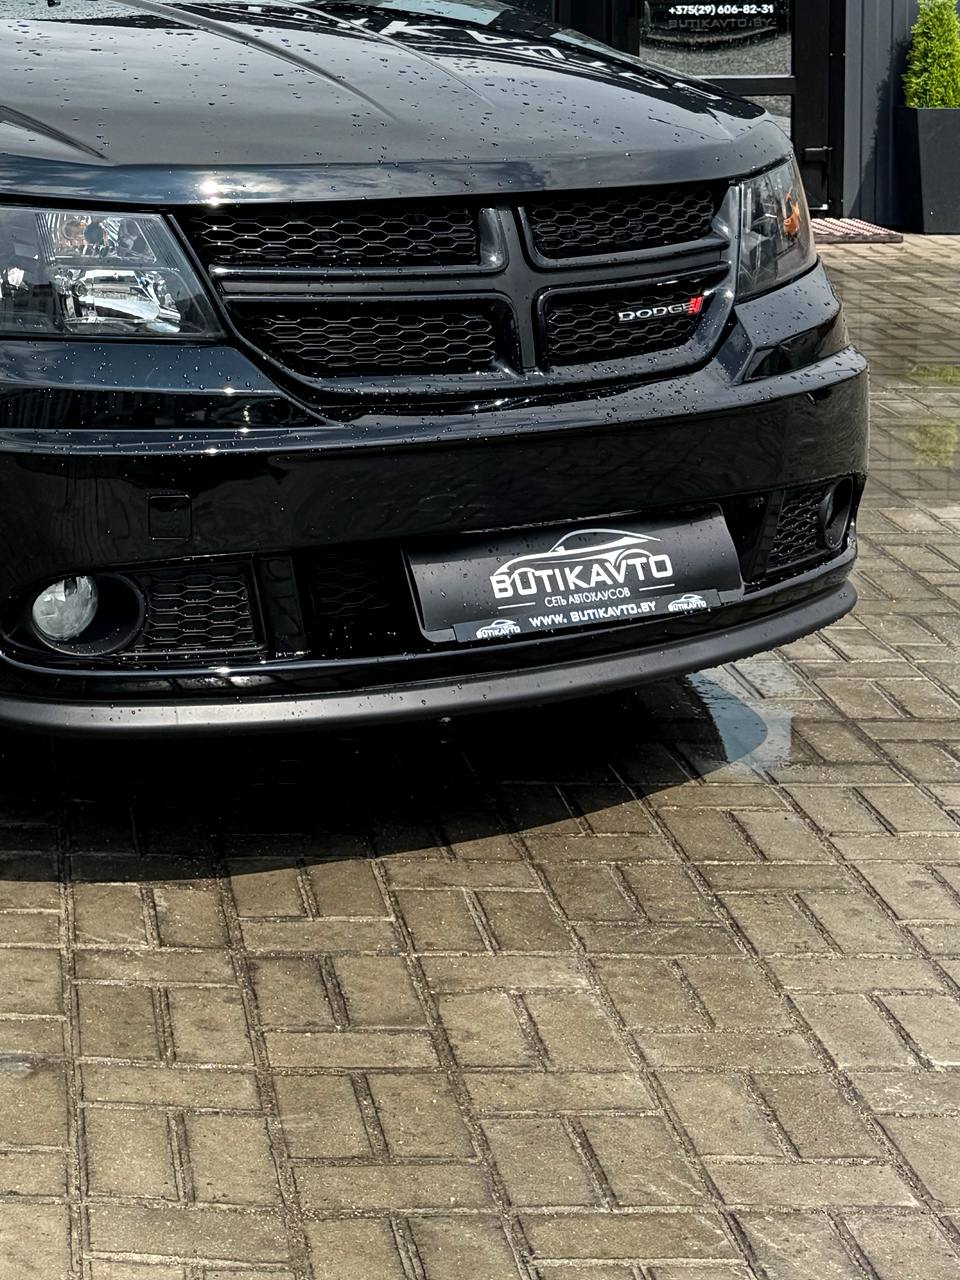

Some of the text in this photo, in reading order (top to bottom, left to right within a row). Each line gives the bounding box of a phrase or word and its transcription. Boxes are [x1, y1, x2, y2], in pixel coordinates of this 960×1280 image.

[668, 4, 774, 16] +375(29) 606-82-31
[618, 303, 696, 321] DODGE
[490, 554, 673, 599] BUTIKAVTO
[544, 587, 631, 608] СЕТЬ АВТОХАУСОВ
[529, 601, 656, 628] WWW. BUTIKAVTO.BY
